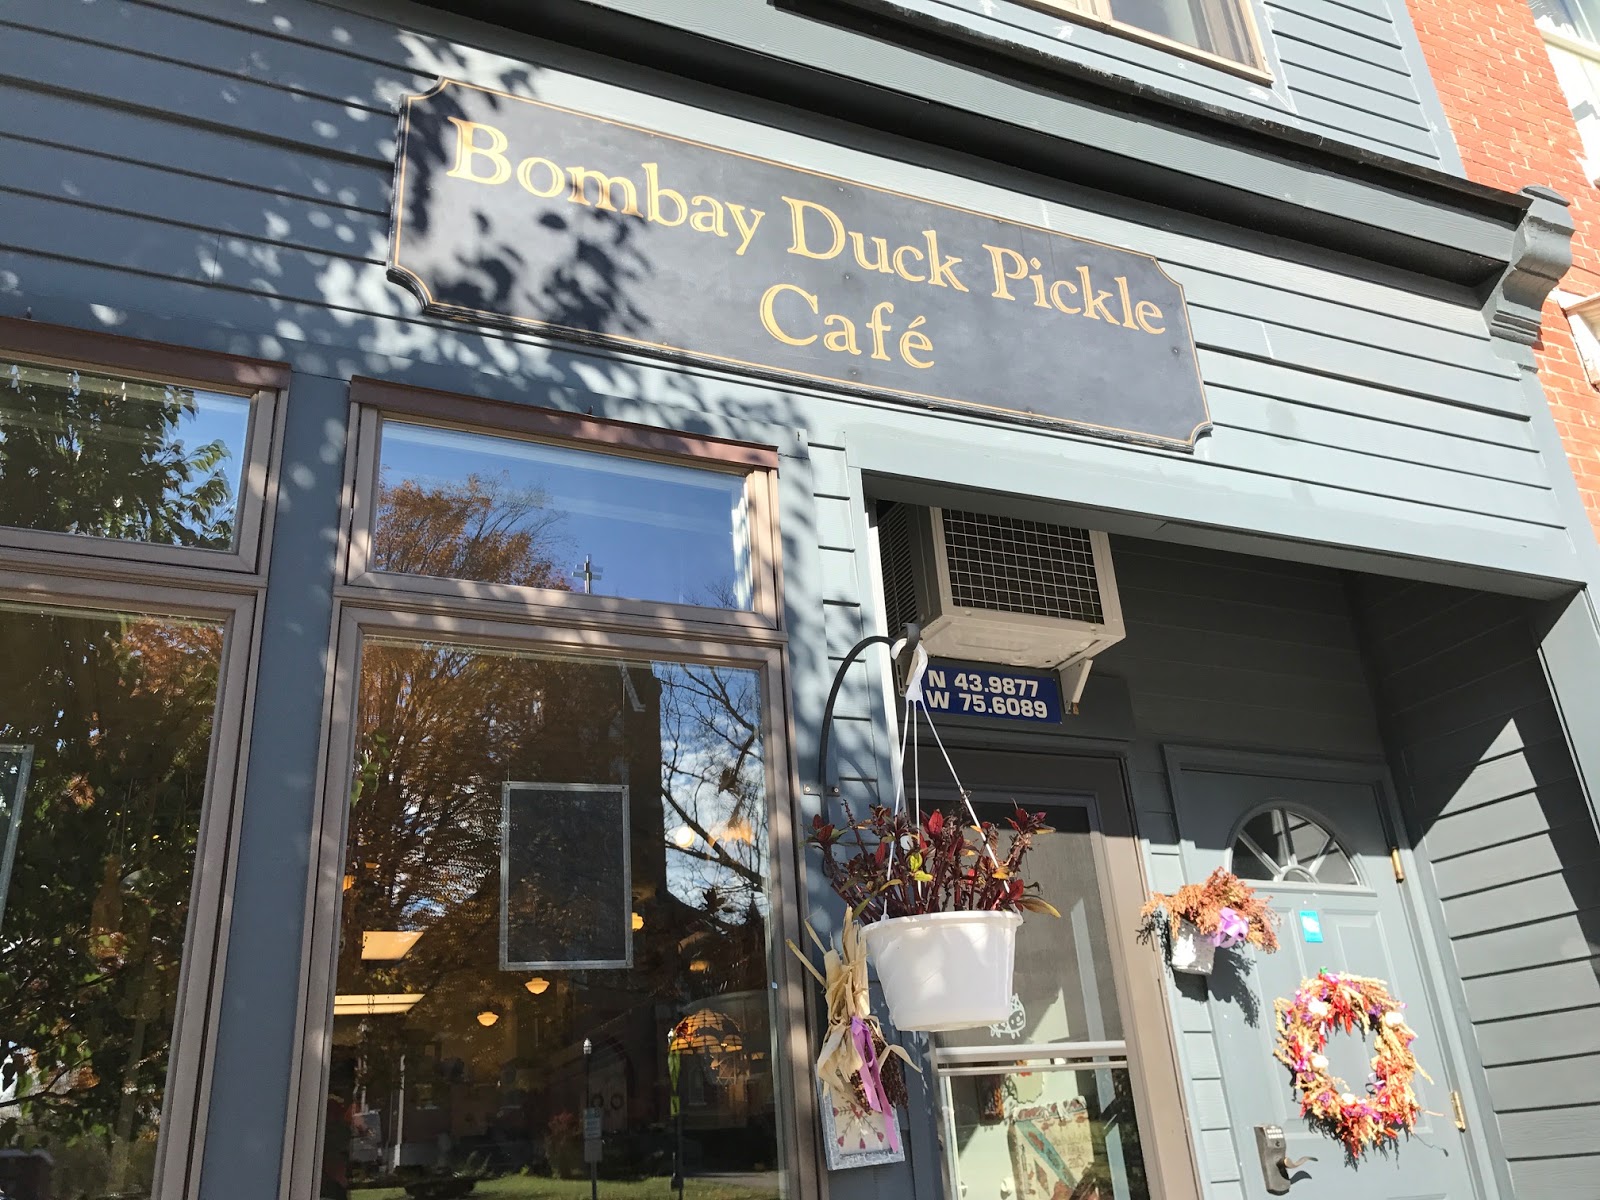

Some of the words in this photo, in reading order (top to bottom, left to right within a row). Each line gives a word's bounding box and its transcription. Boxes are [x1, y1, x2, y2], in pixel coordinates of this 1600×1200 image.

[446, 116, 766, 255] Bombay
[783, 197, 969, 293] Duck
[981, 245, 1166, 335] Pickle
[760, 284, 936, 369] Café
[926, 690, 950, 709] W
[958, 694, 1047, 718] 75.6089
[928, 670, 947, 688] N
[954, 673, 1038, 697] 43.9877
